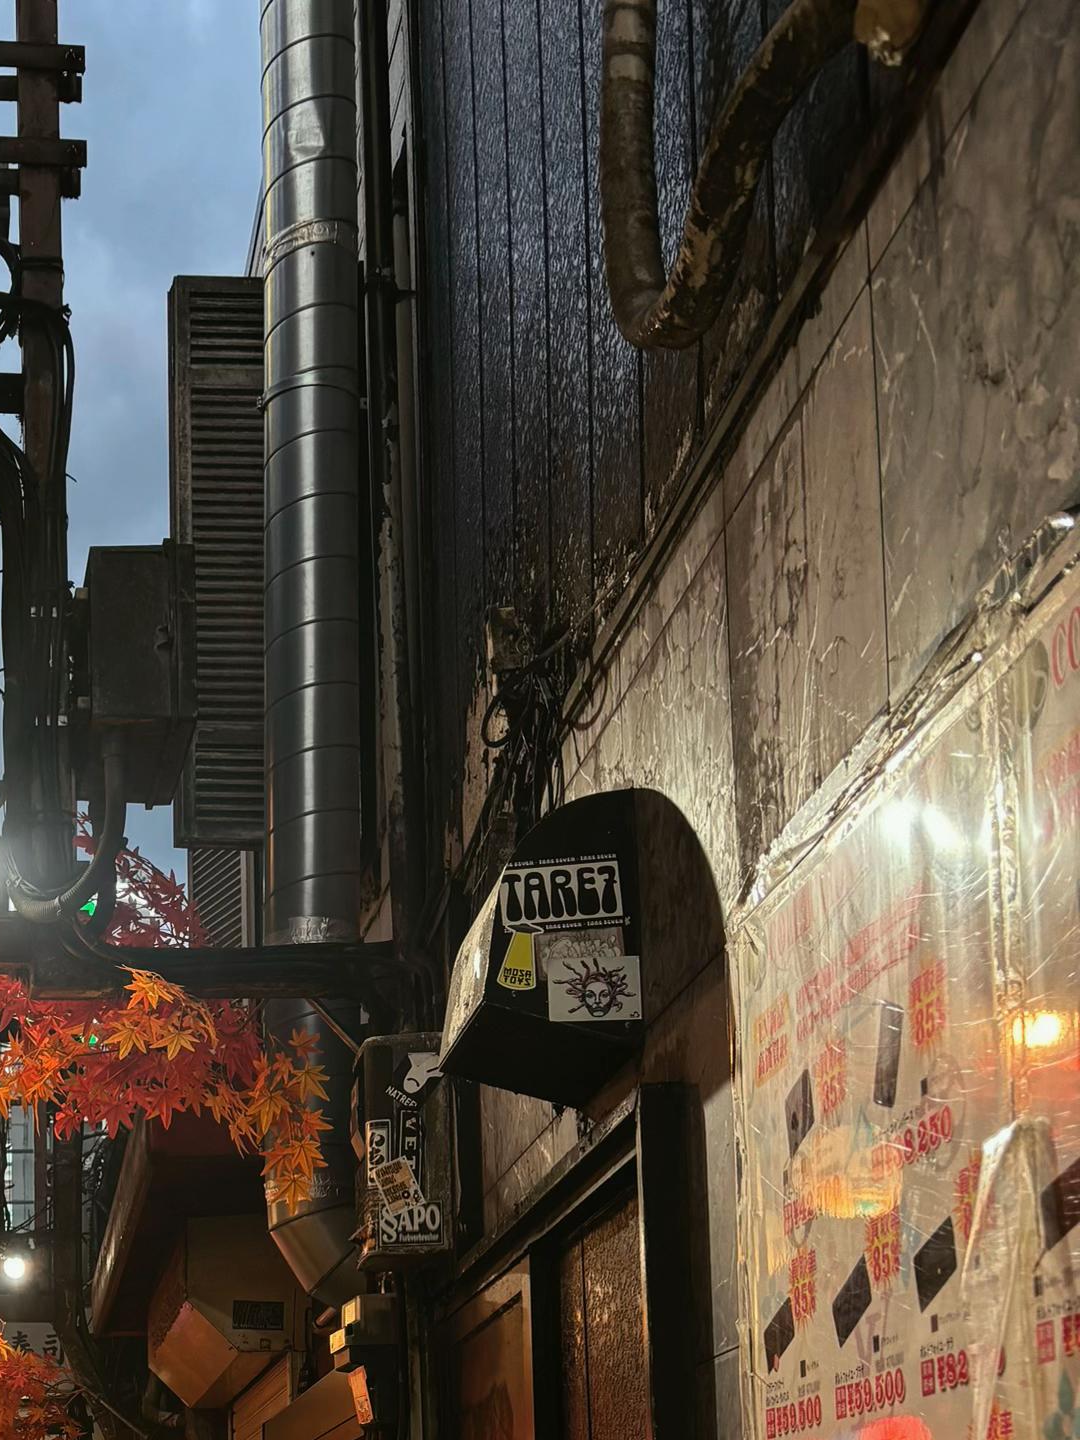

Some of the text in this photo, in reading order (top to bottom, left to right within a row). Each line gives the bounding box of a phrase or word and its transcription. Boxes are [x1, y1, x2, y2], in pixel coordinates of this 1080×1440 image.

[503, 976, 532, 988] TOYS
[847, 1367, 907, 1418] ¥59,500
[776, 1394, 823, 1437] ¥59,500
